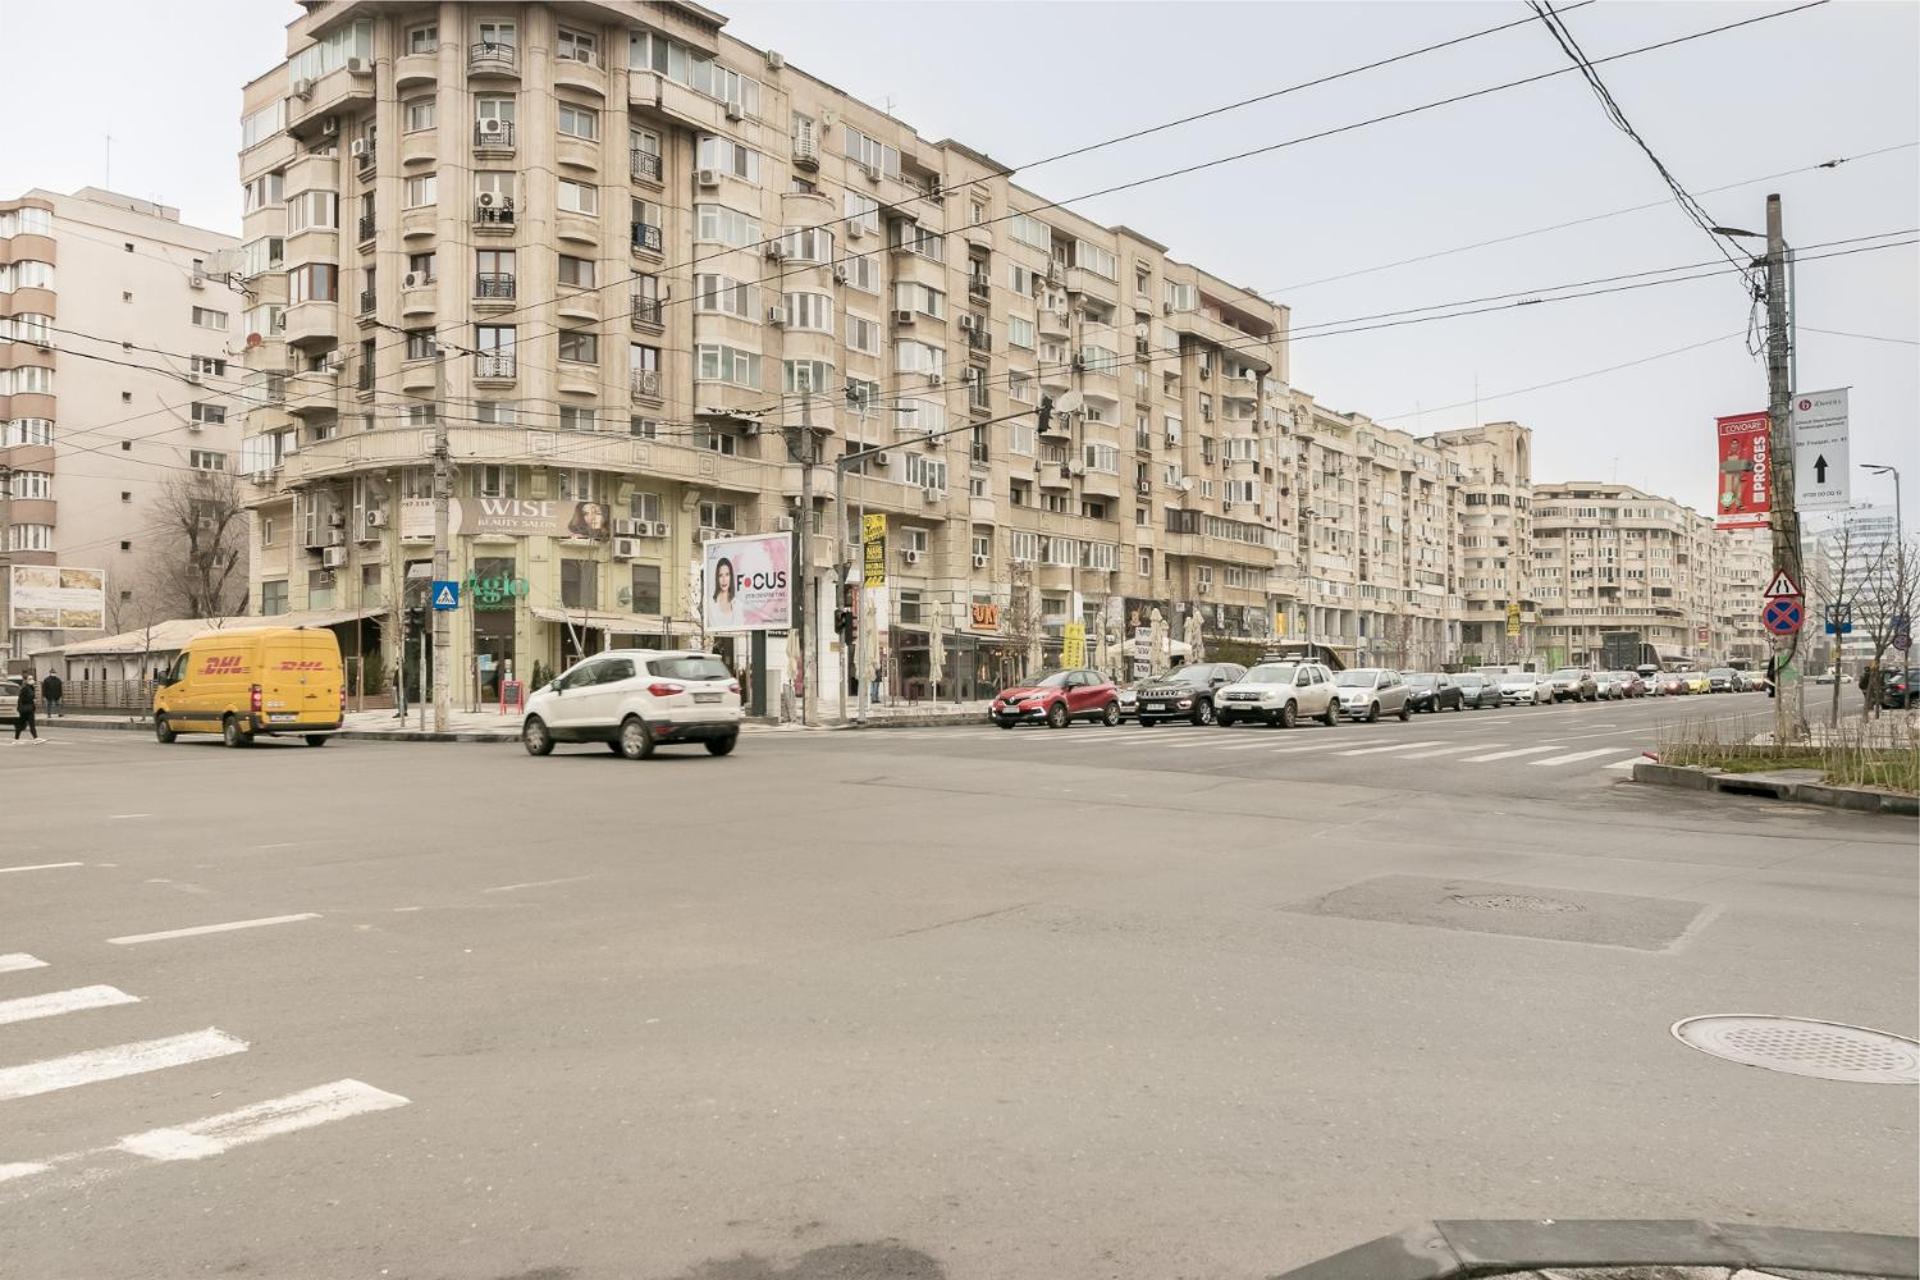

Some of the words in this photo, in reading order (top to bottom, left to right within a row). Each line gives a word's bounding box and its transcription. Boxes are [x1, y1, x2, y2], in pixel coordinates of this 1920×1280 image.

[1753, 436, 1766, 491] PROGES
[480, 499, 557, 518] WISE
[478, 517, 520, 527] BEAUTY
[521, 520, 558, 529] SALON
[205, 656, 243, 675] DHL
[281, 661, 325, 671] DHL
